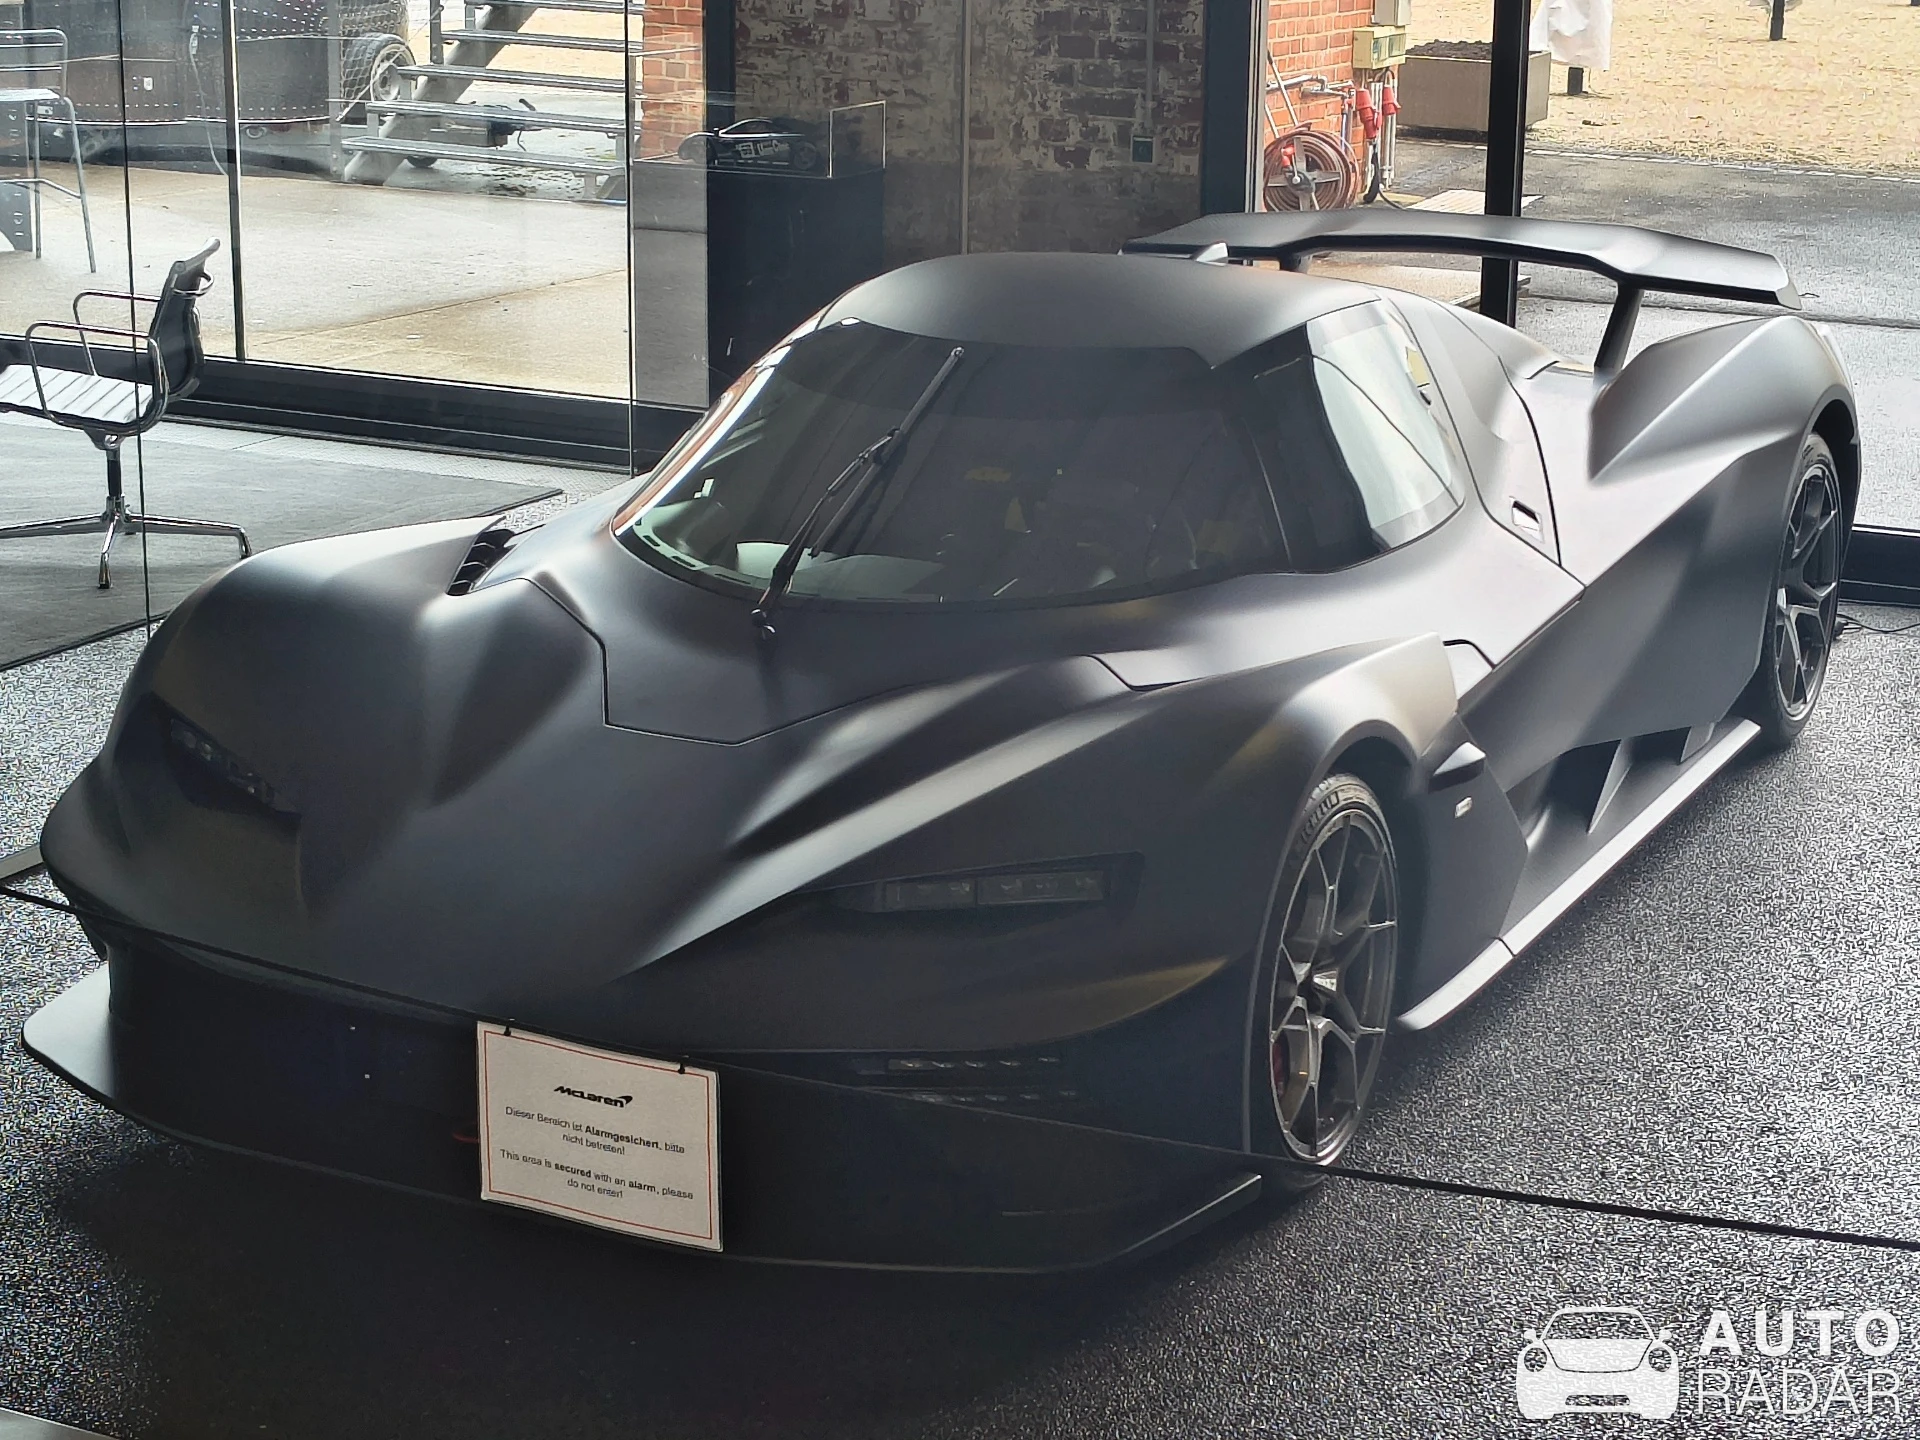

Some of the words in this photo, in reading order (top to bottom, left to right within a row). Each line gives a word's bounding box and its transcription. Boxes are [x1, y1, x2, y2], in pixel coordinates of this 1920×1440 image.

[554, 1085, 626, 1108] McLaren
[505, 1106, 535, 1120] Dieser
[537, 1113, 570, 1128] Bereich
[572, 1122, 583, 1132] ist
[585, 1126, 662, 1150] Alarmgesichert,
[664, 1141, 685, 1154] bitte
[562, 1133, 584, 1146] nicht
[586, 1137, 625, 1155] betreten!
[500, 1149, 520, 1161] This
[522, 1155, 542, 1166] area
[544, 1158, 552, 1168] is
[554, 1162, 592, 1178] secured
[594, 1172, 612, 1184] with
[614, 1177, 626, 1187] an
[628, 1180, 660, 1195] alarm,
[662, 1186, 694, 1200] please
[567, 1178, 579, 1188] do
[581, 1182, 595, 1193] not
[597, 1187, 624, 1199] enter!
